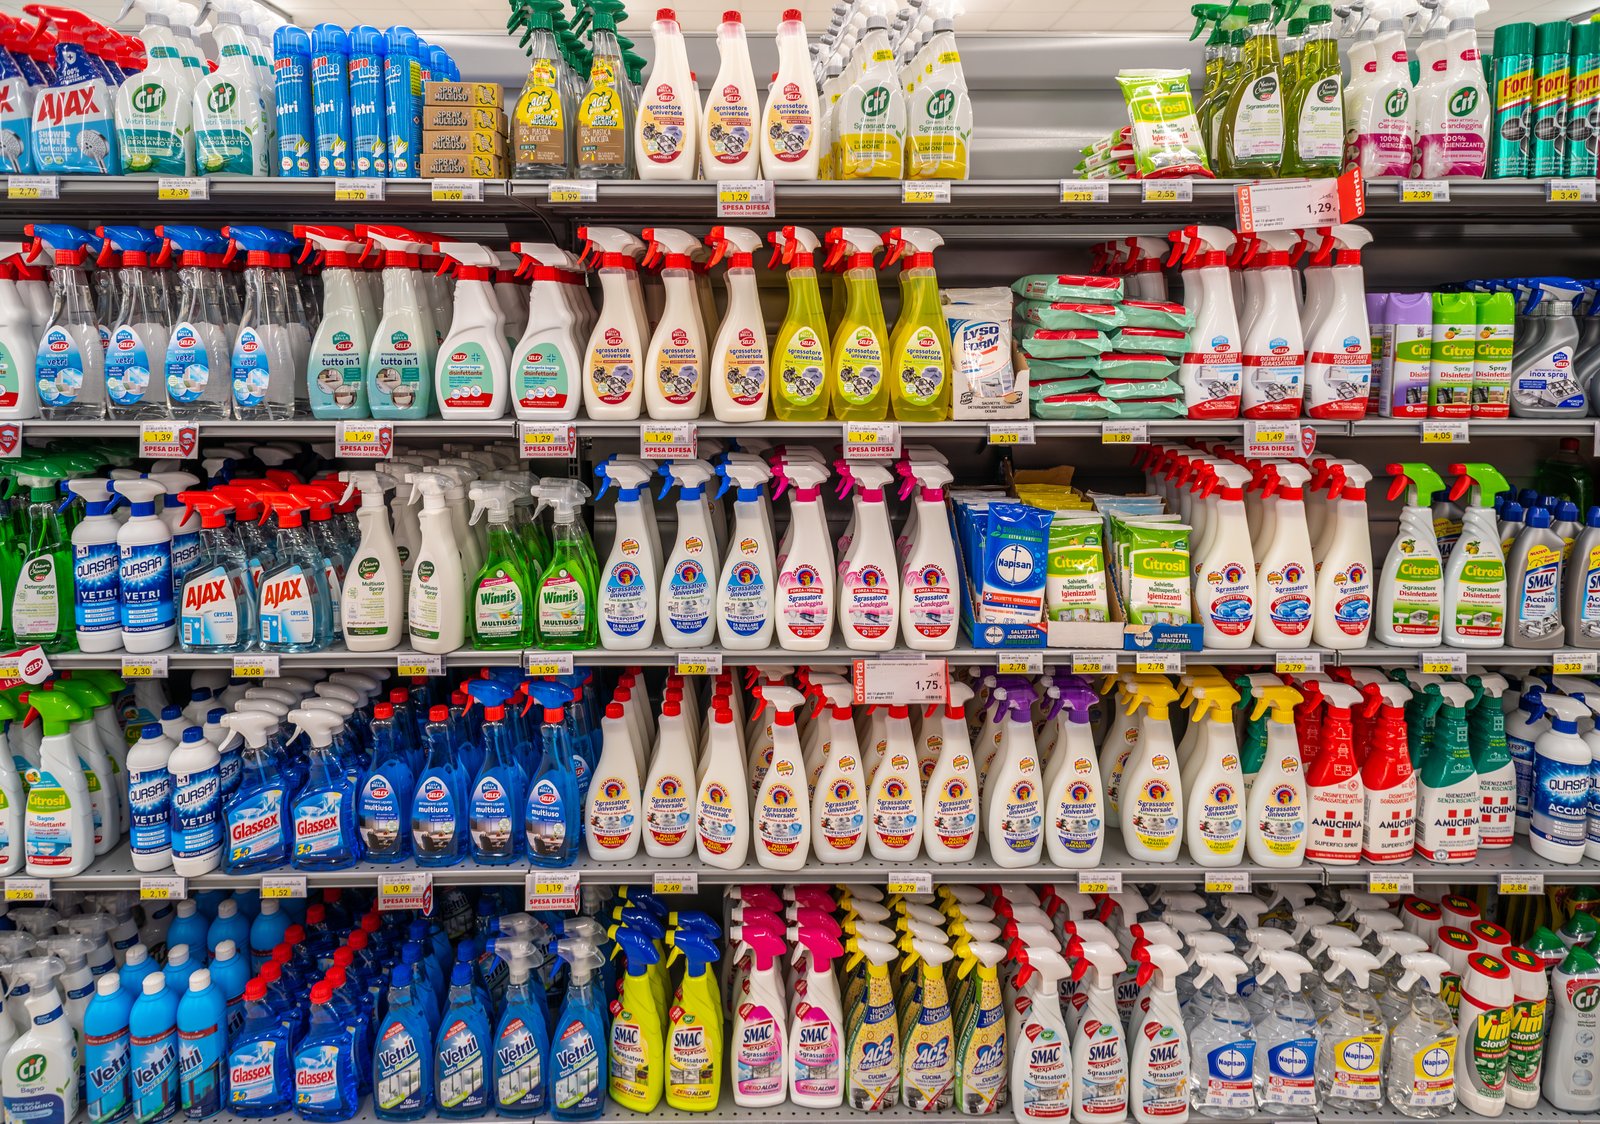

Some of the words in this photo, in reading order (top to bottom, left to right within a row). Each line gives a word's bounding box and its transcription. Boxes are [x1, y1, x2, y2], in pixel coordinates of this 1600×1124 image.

[438, 86, 463, 94] SPRAY
[134, 84, 164, 112] Cif
[209, 83, 234, 112] Cif
[864, 90, 887, 114] Cif
[1387, 89, 1407, 114] Cif
[1451, 89, 1476, 114] Cif
[38, 85, 100, 126] AJAX
[929, 92, 953, 116] Cif
[38, 130, 70, 138] SHOWER
[39, 138, 66, 146] POWER
[19, 187, 38, 195] 2,79
[170, 188, 188, 196] 2,39
[1157, 190, 1175, 198] 2,55
[1414, 191, 1430, 199] 2,39
[443, 192, 460, 200] 1,69
[561, 193, 578, 201] 1,99
[731, 193, 748, 201] 1,29
[1241, 188, 1251, 230] offerta
[1307, 203, 1331, 215] 1,29
[963, 326, 999, 343] LYSO
[47, 358, 68, 367] vetri
[175, 354, 195, 362] vetri
[322, 357, 344, 366] tutto
[346, 357, 354, 366] in
[380, 357, 402, 366] tutto
[404, 357, 412, 366] in
[1548, 371, 1568, 380] spray
[154, 433, 171, 442] 1,39
[355, 433, 372, 442] 1,49
[534, 434, 551, 443] 1,29
[655, 434, 671, 442] 1,49
[858, 434, 875, 442] 1,49
[1000, 434, 1017, 443] 2,13
[1114, 433, 1130, 442] 1,89
[1266, 433, 1282, 441] 1,49
[1433, 432, 1451, 440] 4,05
[121, 556, 162, 578] QUASAR
[998, 558, 1032, 570] Napisan
[1142, 557, 1186, 571] Citrosil
[1400, 564, 1439, 576] Citrosil
[1527, 572, 1555, 589] SMAC
[81, 589, 117, 600] VETRI
[125, 589, 160, 600] VETRI
[186, 579, 226, 611] AJAX
[264, 578, 302, 609] AJAX
[1061, 589, 1097, 597] Igienizzanti
[481, 591, 516, 605] Winni's
[408, 666, 425, 675] 1,59
[538, 666, 555, 674] 1,95
[688, 666, 704, 674] 2,79
[1010, 663, 1026, 671] 2,78
[1285, 663, 1302, 671] 2,79
[1432, 665, 1448, 673] 2,52
[1564, 663, 1581, 671] 3,23
[243, 668, 261, 676] 2,08
[916, 681, 938, 691] 1,75
[177, 778, 217, 805] QUASAR
[180, 810, 216, 827] VETRI
[1312, 817, 1362, 829] AMUCHINA
[1434, 818, 1479, 827] AMUCHINA
[233, 813, 278, 841] Glassex
[297, 815, 337, 836] Glassex
[393, 885, 410, 893] 0,99
[545, 884, 561, 892] 1,19
[898, 884, 914, 892] 2,79
[1216, 883, 1231, 891] 2,79
[150, 890, 167, 898] 2,19
[272, 888, 288, 896] 1,52
[1575, 988, 1599, 1007] Cif
[1478, 1014, 1511, 1039] Vim
[614, 1028, 638, 1044] SMAC
[744, 1025, 772, 1042] SMAC
[800, 1027, 828, 1042] SMAC
[1511, 1032, 1540, 1040] clorex
[675, 1031, 702, 1047] SMAC
[1481, 1039, 1507, 1048] clorex
[379, 1037, 415, 1068] Vetril
[441, 1034, 478, 1066] Vetril
[498, 1033, 535, 1066] Vetril
[864, 1042, 893, 1060] ACE
[917, 1045, 947, 1062] ACE
[1089, 1042, 1118, 1060] SMAC
[1150, 1045, 1178, 1062] SMAC
[1031, 1047, 1060, 1063] SMAC
[1219, 1059, 1244, 1067] Napisan
[1279, 1056, 1306, 1064] Napisan
[18, 1057, 44, 1080] Cif
[232, 1064, 271, 1084] Glassex
[298, 1069, 334, 1085] Glassex
[21, 1086, 45, 1094] Bagno
